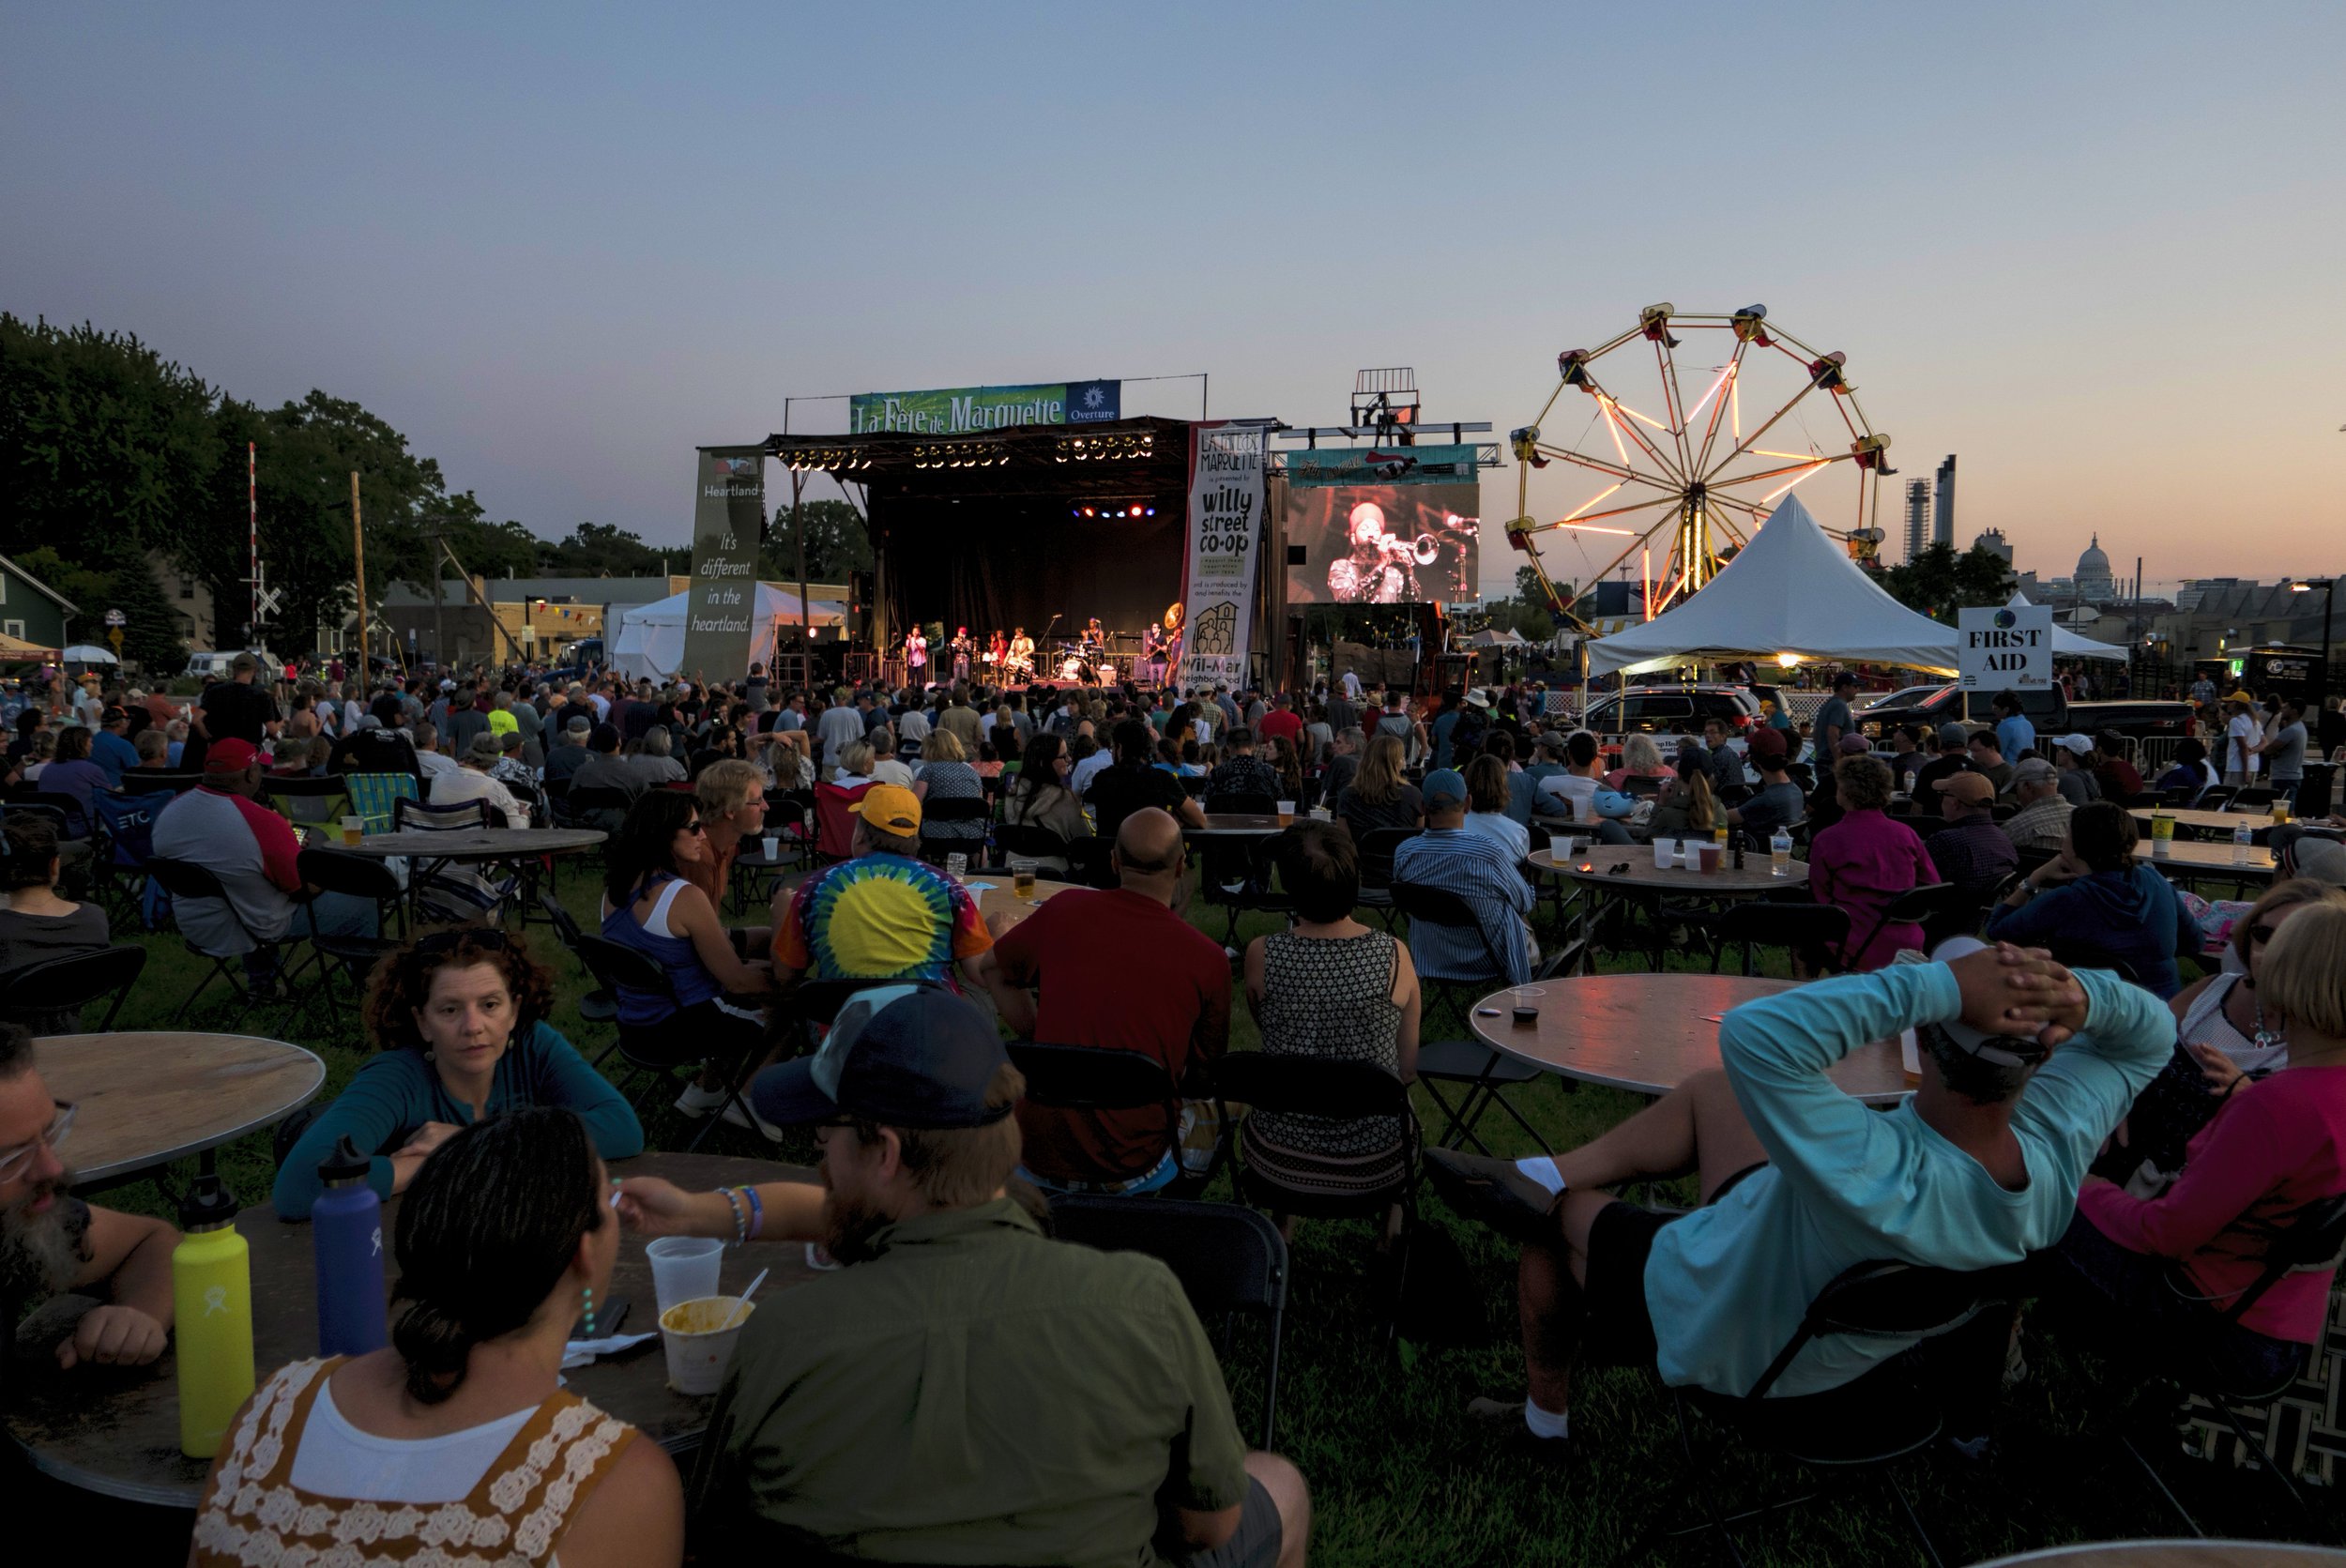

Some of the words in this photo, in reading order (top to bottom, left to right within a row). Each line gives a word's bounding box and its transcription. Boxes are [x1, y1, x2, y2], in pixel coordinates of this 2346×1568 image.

[856, 407, 878, 434] La
[884, 398, 926, 433] Fête
[929, 415, 943, 434] de
[950, 396, 1060, 434] Marquette
[1071, 409, 1115, 421] Overture
[705, 483, 758, 497] Heartland
[1203, 484, 1253, 514] willy
[1202, 514, 1249, 533] street
[701, 557, 751, 579] different
[708, 588, 720, 605] in
[724, 587, 741, 605] the
[692, 615, 750, 632] heartland.
[1969, 630, 2042, 648] FIRST
[1182, 658, 1241, 674] Wil-Mar
[1983, 654, 2027, 672] AID
[1179, 673, 1241, 684] Neighborod
[117, 811, 151, 830] ETC
